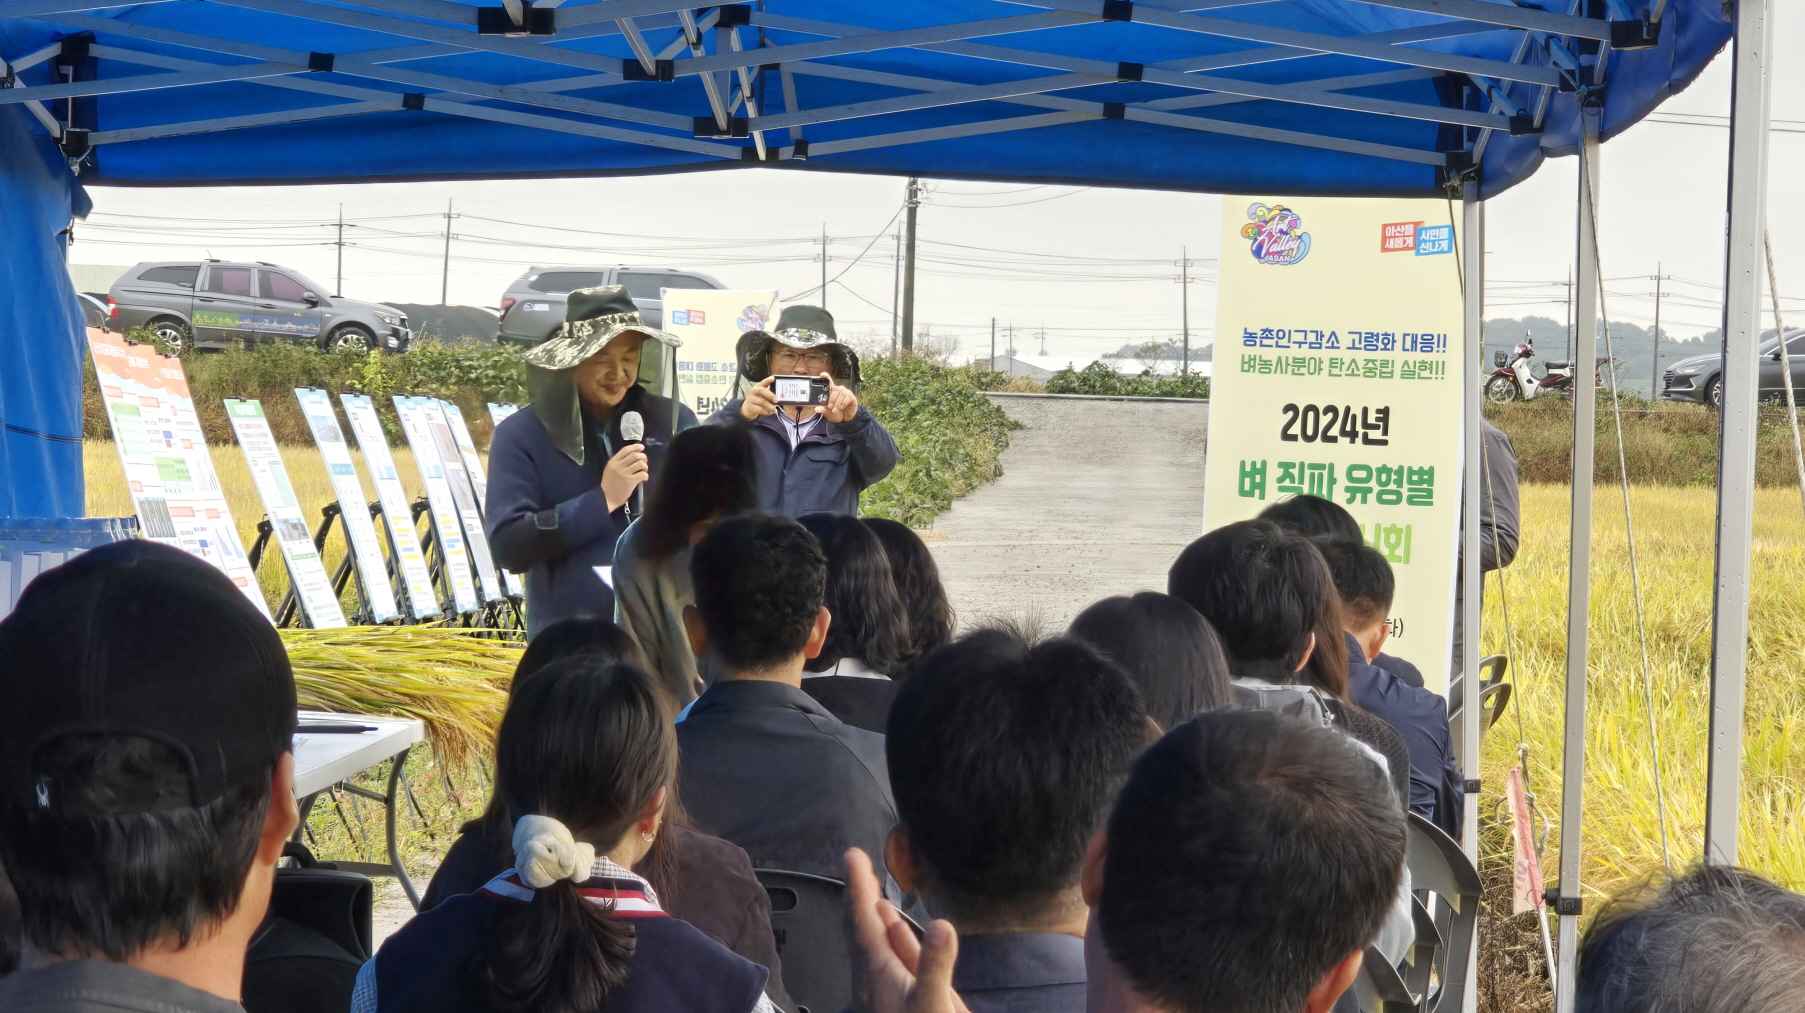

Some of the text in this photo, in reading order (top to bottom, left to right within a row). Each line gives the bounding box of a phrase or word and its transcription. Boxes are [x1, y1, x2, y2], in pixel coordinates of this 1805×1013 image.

[1263, 215, 1297, 234] Art
[1252, 230, 1301, 257] Valley
[1243, 327, 1448, 353] 농촌인구감소 고령화 대응!!
[1240, 353, 1446, 381] 벼농사분야 탄소중립 실현!!
[1280, 402, 1391, 446] 2024년
[1238, 459, 1435, 507] 벼 직파 유형별
